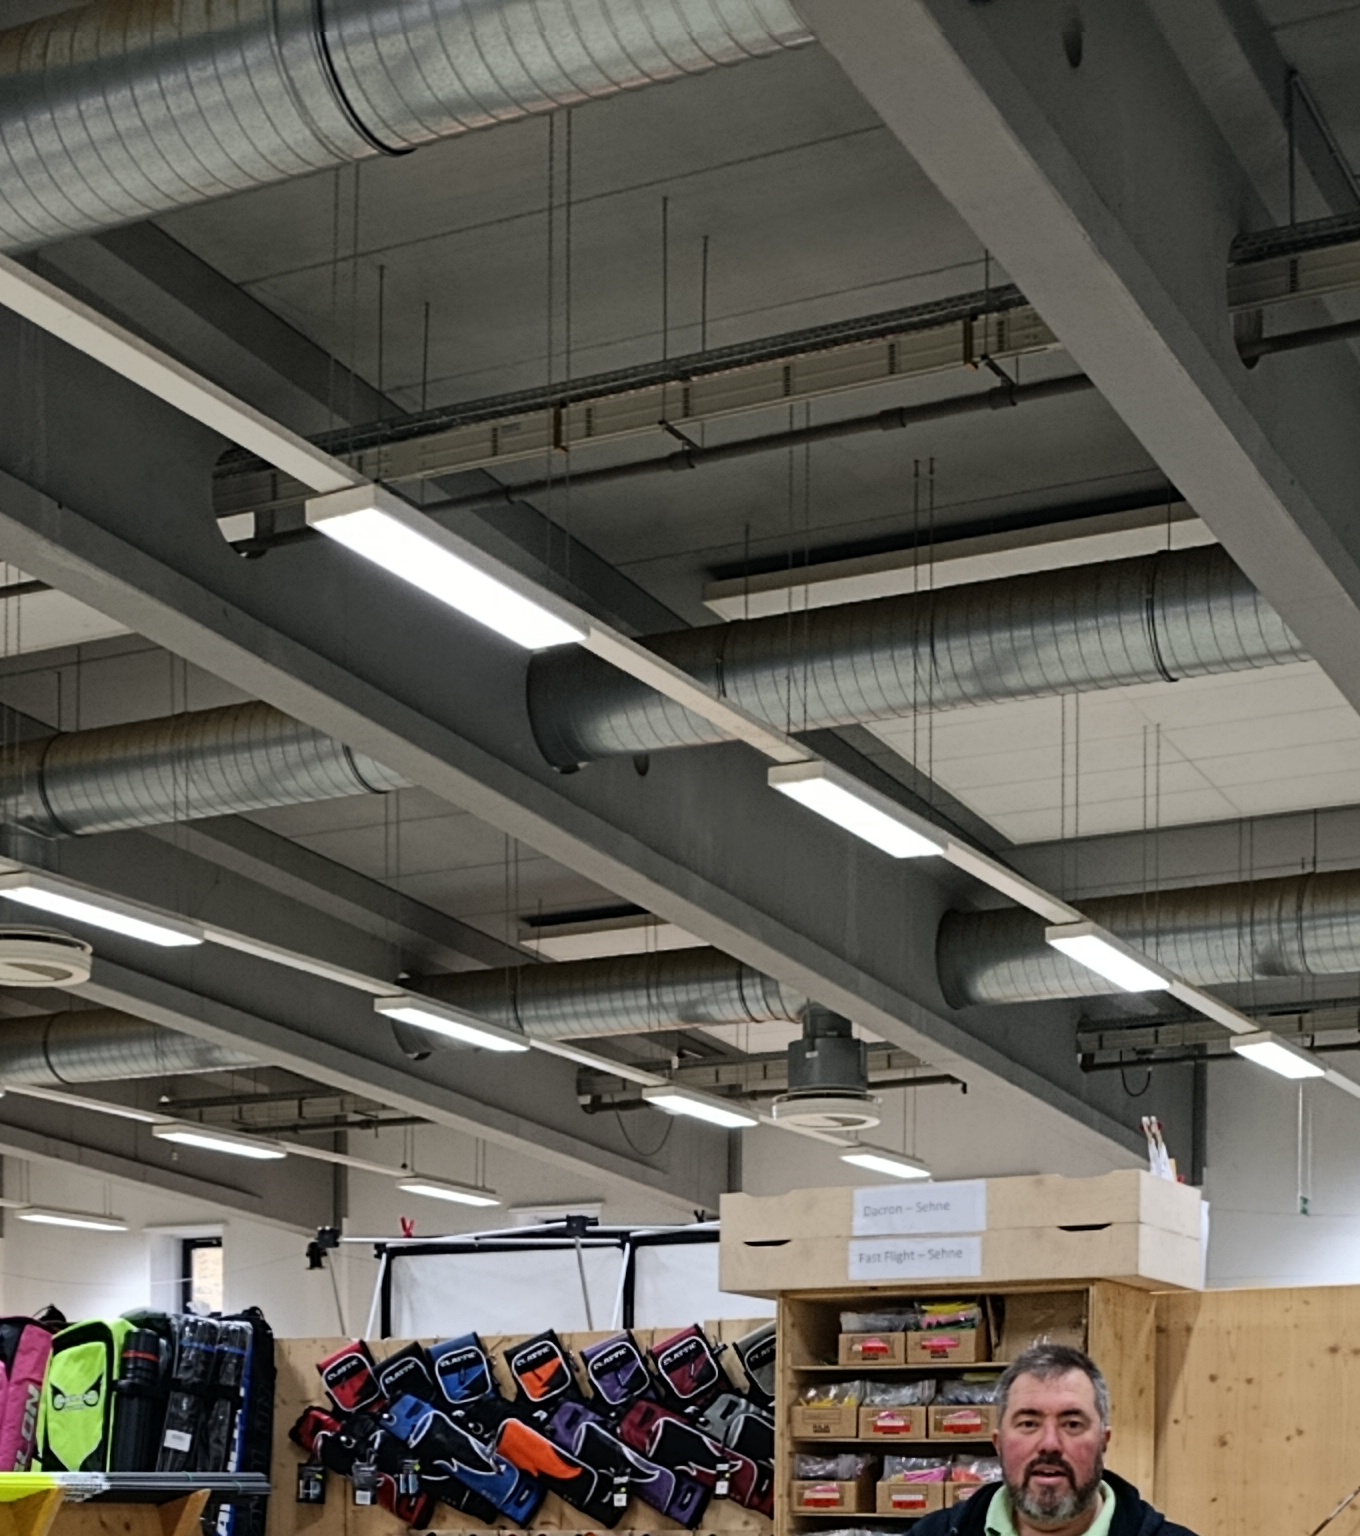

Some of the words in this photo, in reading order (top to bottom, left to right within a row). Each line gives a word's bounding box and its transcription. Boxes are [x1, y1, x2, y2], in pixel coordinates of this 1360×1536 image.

[863, 1205, 902, 1217] Dacron
[916, 1201, 951, 1213] Sehne
[859, 1252, 882, 1263] Fast
[884, 1249, 915, 1264] Flight
[927, 1248, 963, 1260] Sehne
